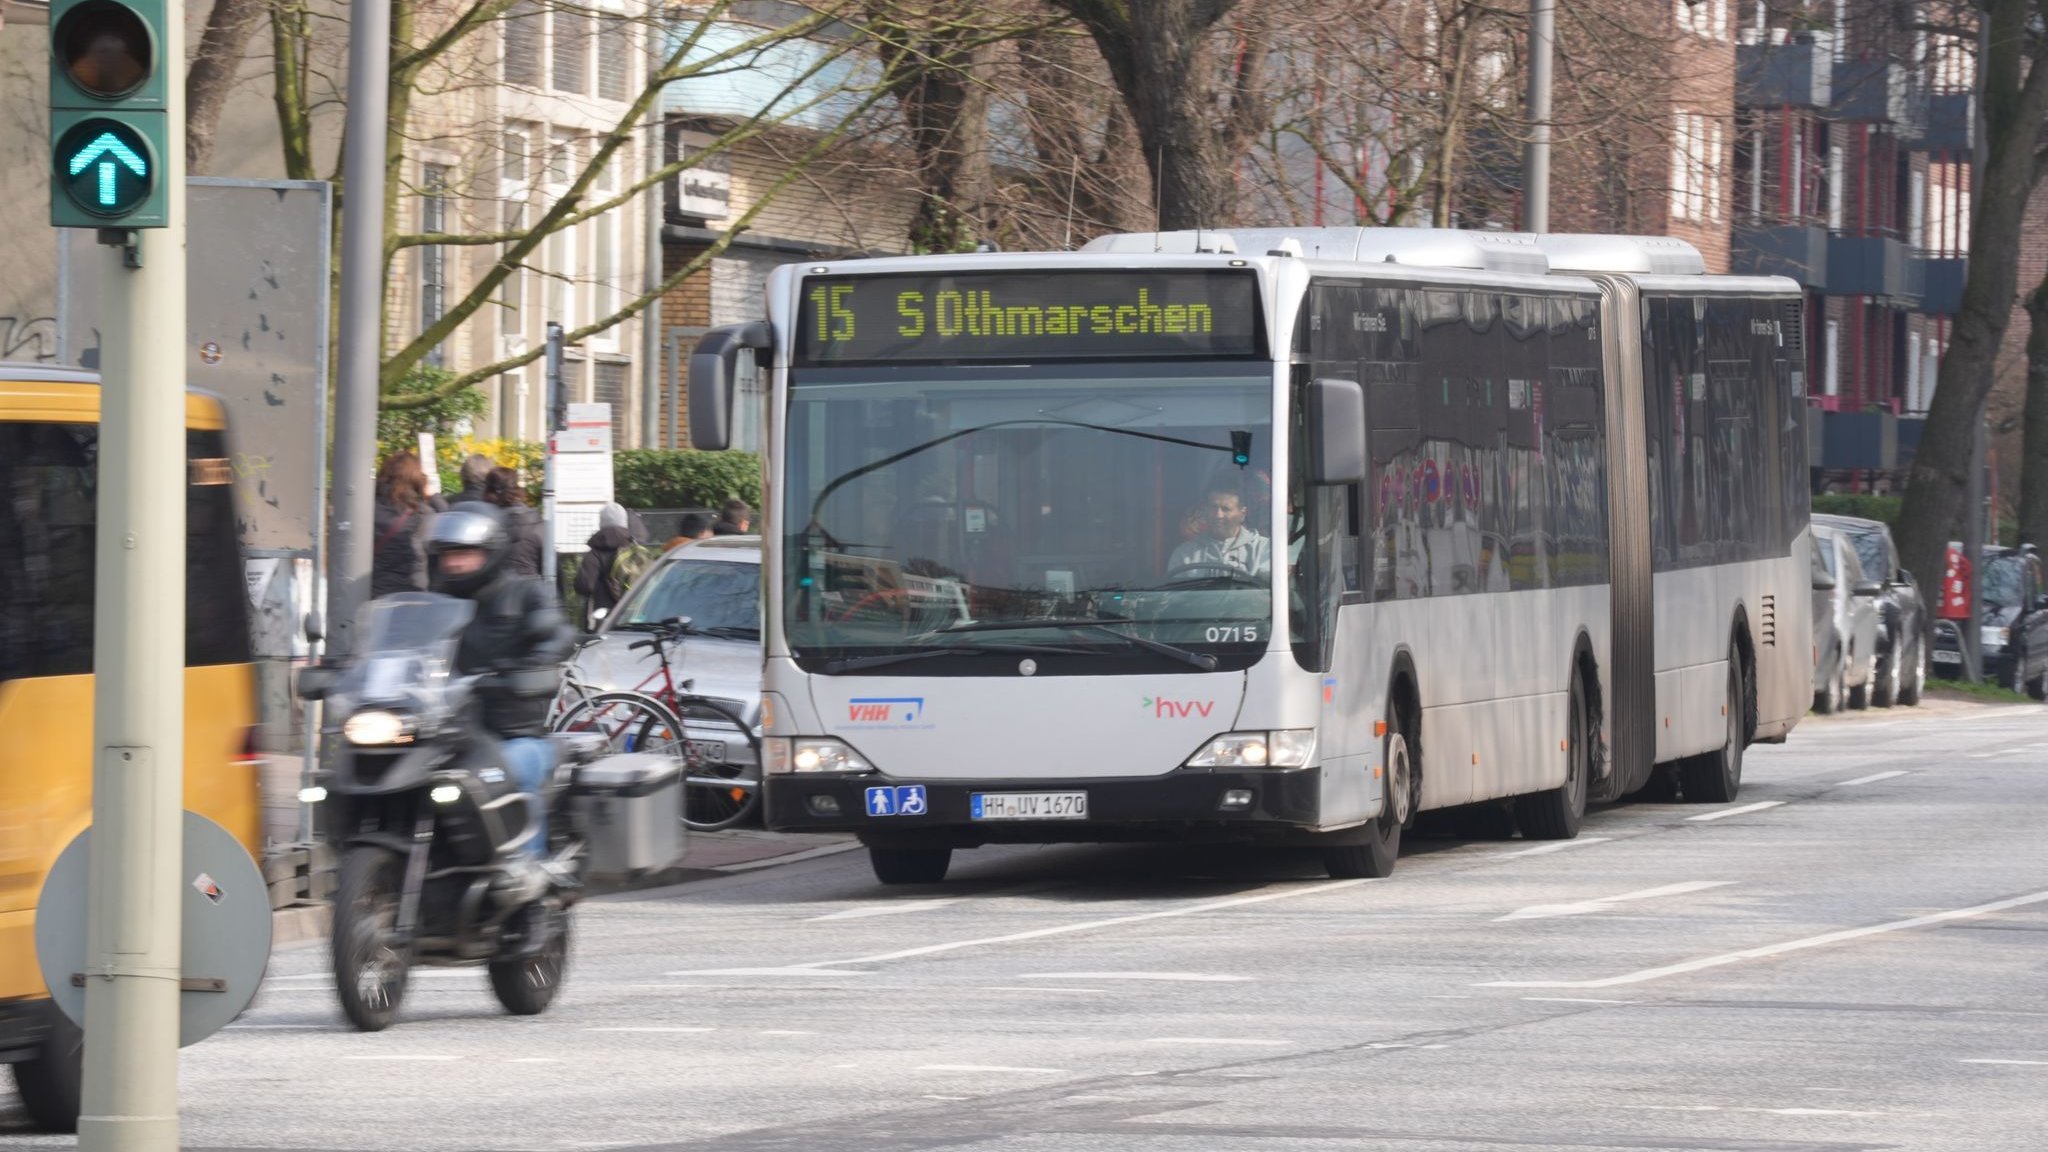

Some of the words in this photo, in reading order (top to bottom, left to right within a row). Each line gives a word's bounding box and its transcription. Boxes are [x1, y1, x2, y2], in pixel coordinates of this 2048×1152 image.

[809, 286, 856, 341] 15
[896, 291, 925, 336] S
[935, 288, 1212, 336] Othmarschen
[1205, 626, 1258, 642] 0715
[848, 704, 891, 721] VHH
[1155, 696, 1215, 718] hvv
[984, 797, 1006, 815] HH
[1017, 796, 1040, 815] UV
[1043, 795, 1085, 814] 1670
